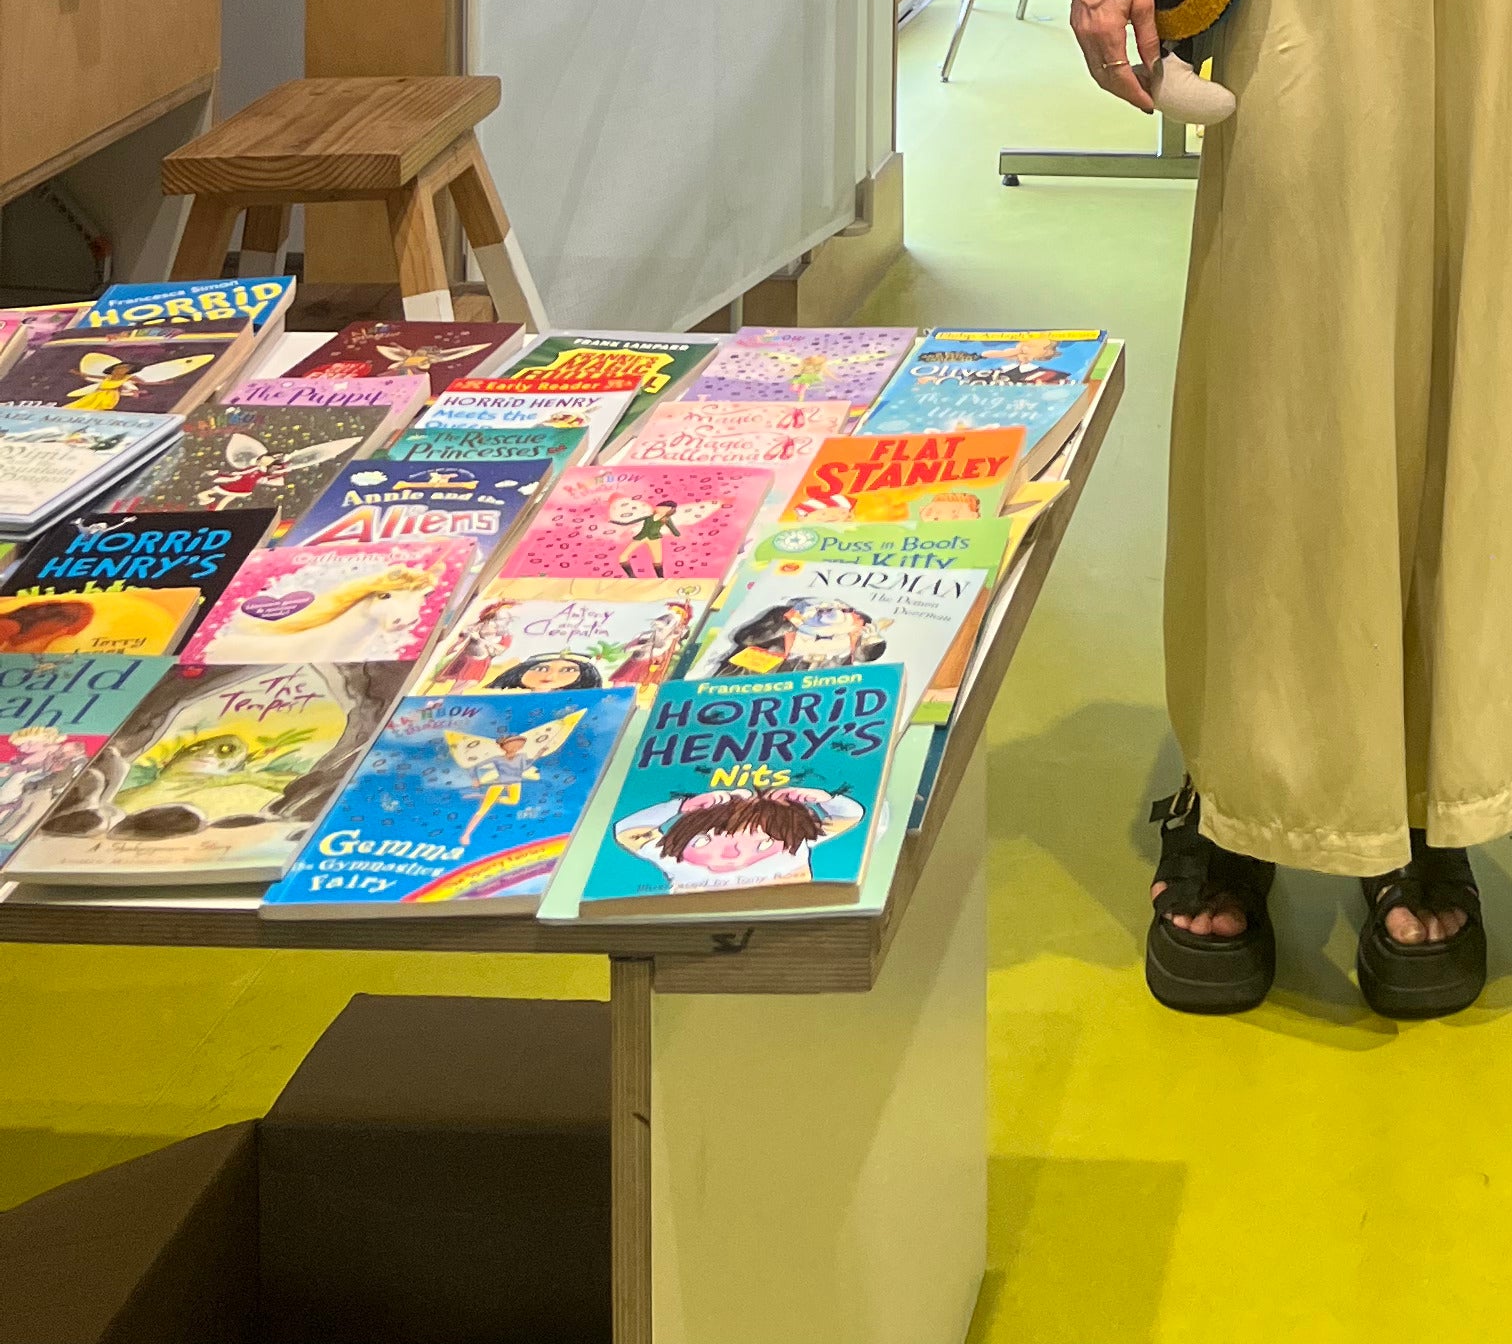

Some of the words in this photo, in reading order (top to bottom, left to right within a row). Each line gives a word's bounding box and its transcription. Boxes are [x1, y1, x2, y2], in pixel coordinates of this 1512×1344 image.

[109, 289, 186, 308] Francesca
[191, 279, 240, 295] Simon
[573, 338, 621, 349] FRANK
[623, 340, 691, 352] LAMPARD
[909, 364, 1005, 380] Oliver
[247, 386, 284, 402] The
[287, 387, 386, 406] Puppy
[486, 381, 534, 392] Early
[538, 381, 601, 391] Reader
[529, 396, 601, 408] HENRY
[432, 409, 496, 421] Meets
[502, 409, 539, 421] the
[434, 431, 457, 442] The
[459, 431, 547, 446] Rescue
[870, 436, 966, 462] FLAT
[402, 442, 546, 461] Princesses
[811, 456, 1010, 495] STANLEY
[342, 489, 424, 506] Annie
[430, 490, 471, 502] and
[477, 494, 505, 506] the
[302, 503, 501, 546] Aliens
[820, 536, 873, 552] Puss
[881, 541, 895, 550] in
[901, 535, 971, 551] Boots
[38, 553, 226, 579] HENRY'S
[808, 569, 971, 599] NORMAN
[869, 592, 894, 603] The
[555, 602, 615, 624] Antony
[0, 659, 143, 694] oald
[697, 679, 795, 696] Francesca
[801, 671, 863, 690] Simon
[0, 694, 100, 729] ahl
[637, 720, 886, 769] HENRY'S
[709, 763, 792, 788] Nits
[318, 829, 466, 861] Gemma
[318, 859, 445, 879] Gymnastics
[309, 873, 398, 894] Fairy
